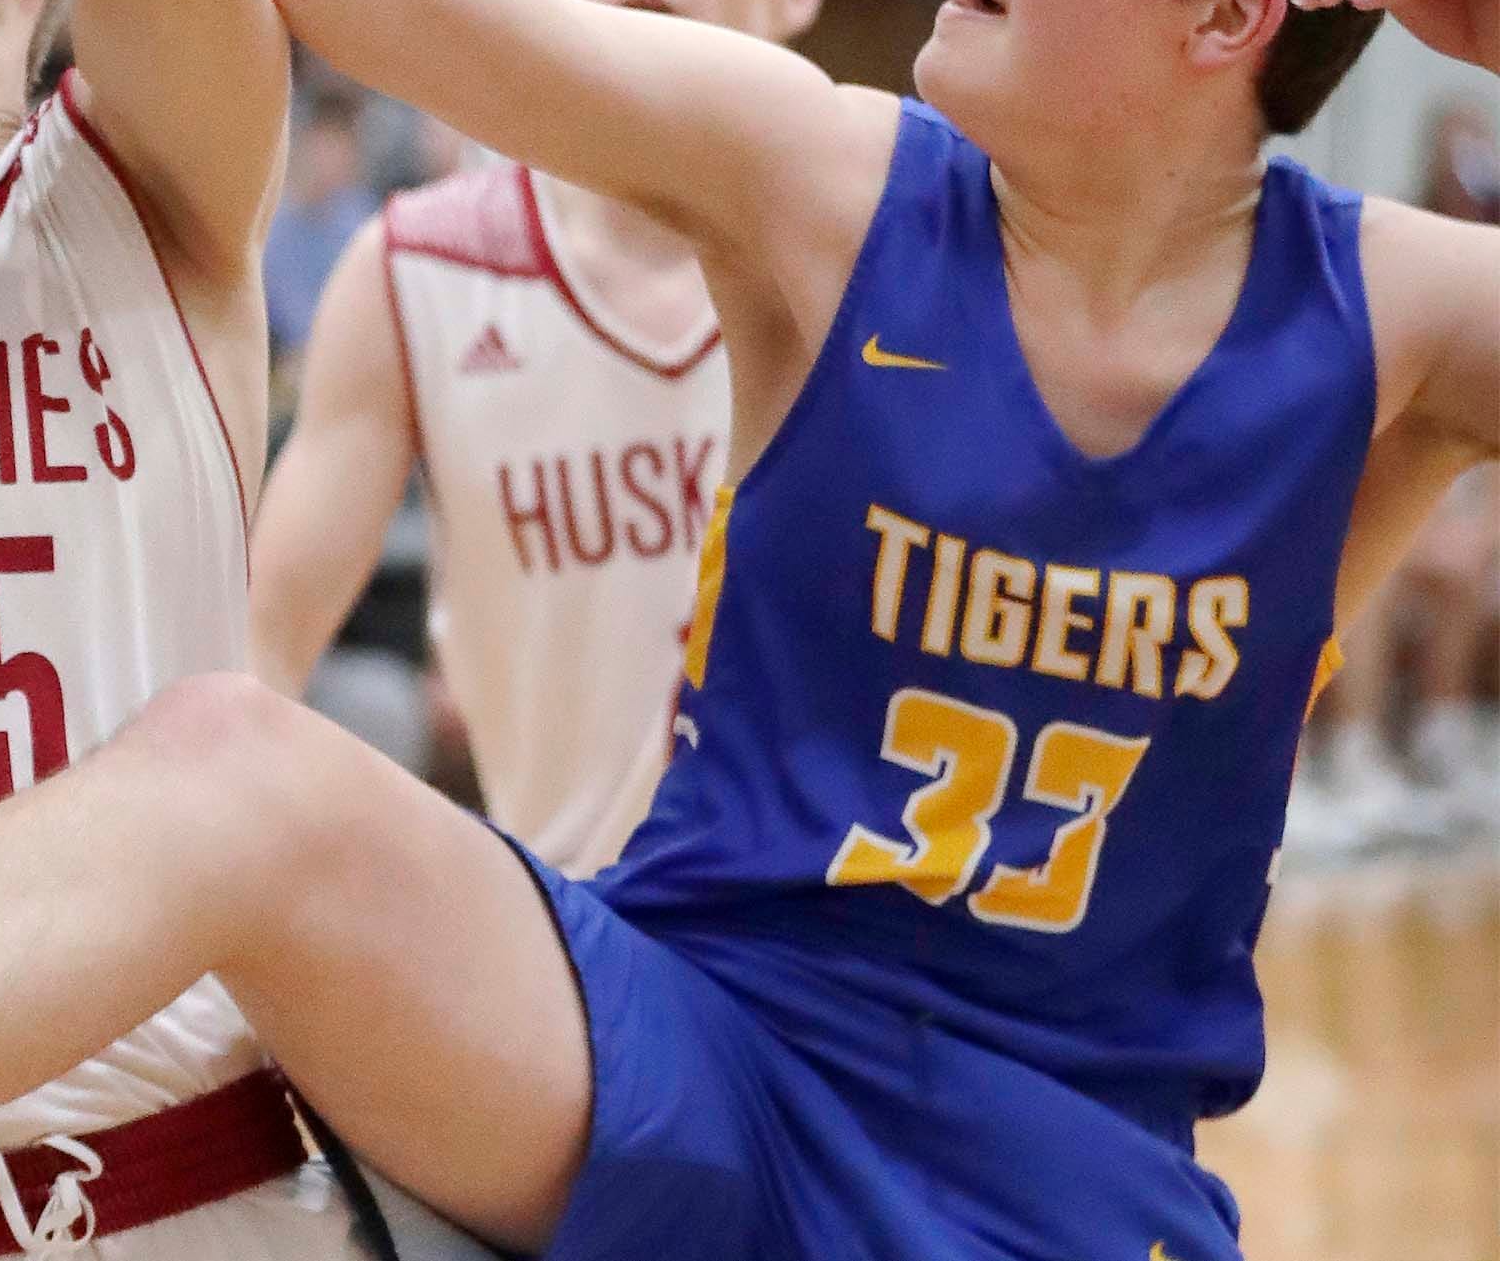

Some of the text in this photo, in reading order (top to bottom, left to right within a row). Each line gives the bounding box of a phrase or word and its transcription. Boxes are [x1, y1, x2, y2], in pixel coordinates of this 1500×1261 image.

[496, 435, 716, 577] HUSK
[864, 503, 1251, 701] TIGERS
[825, 686, 1152, 935] 33
